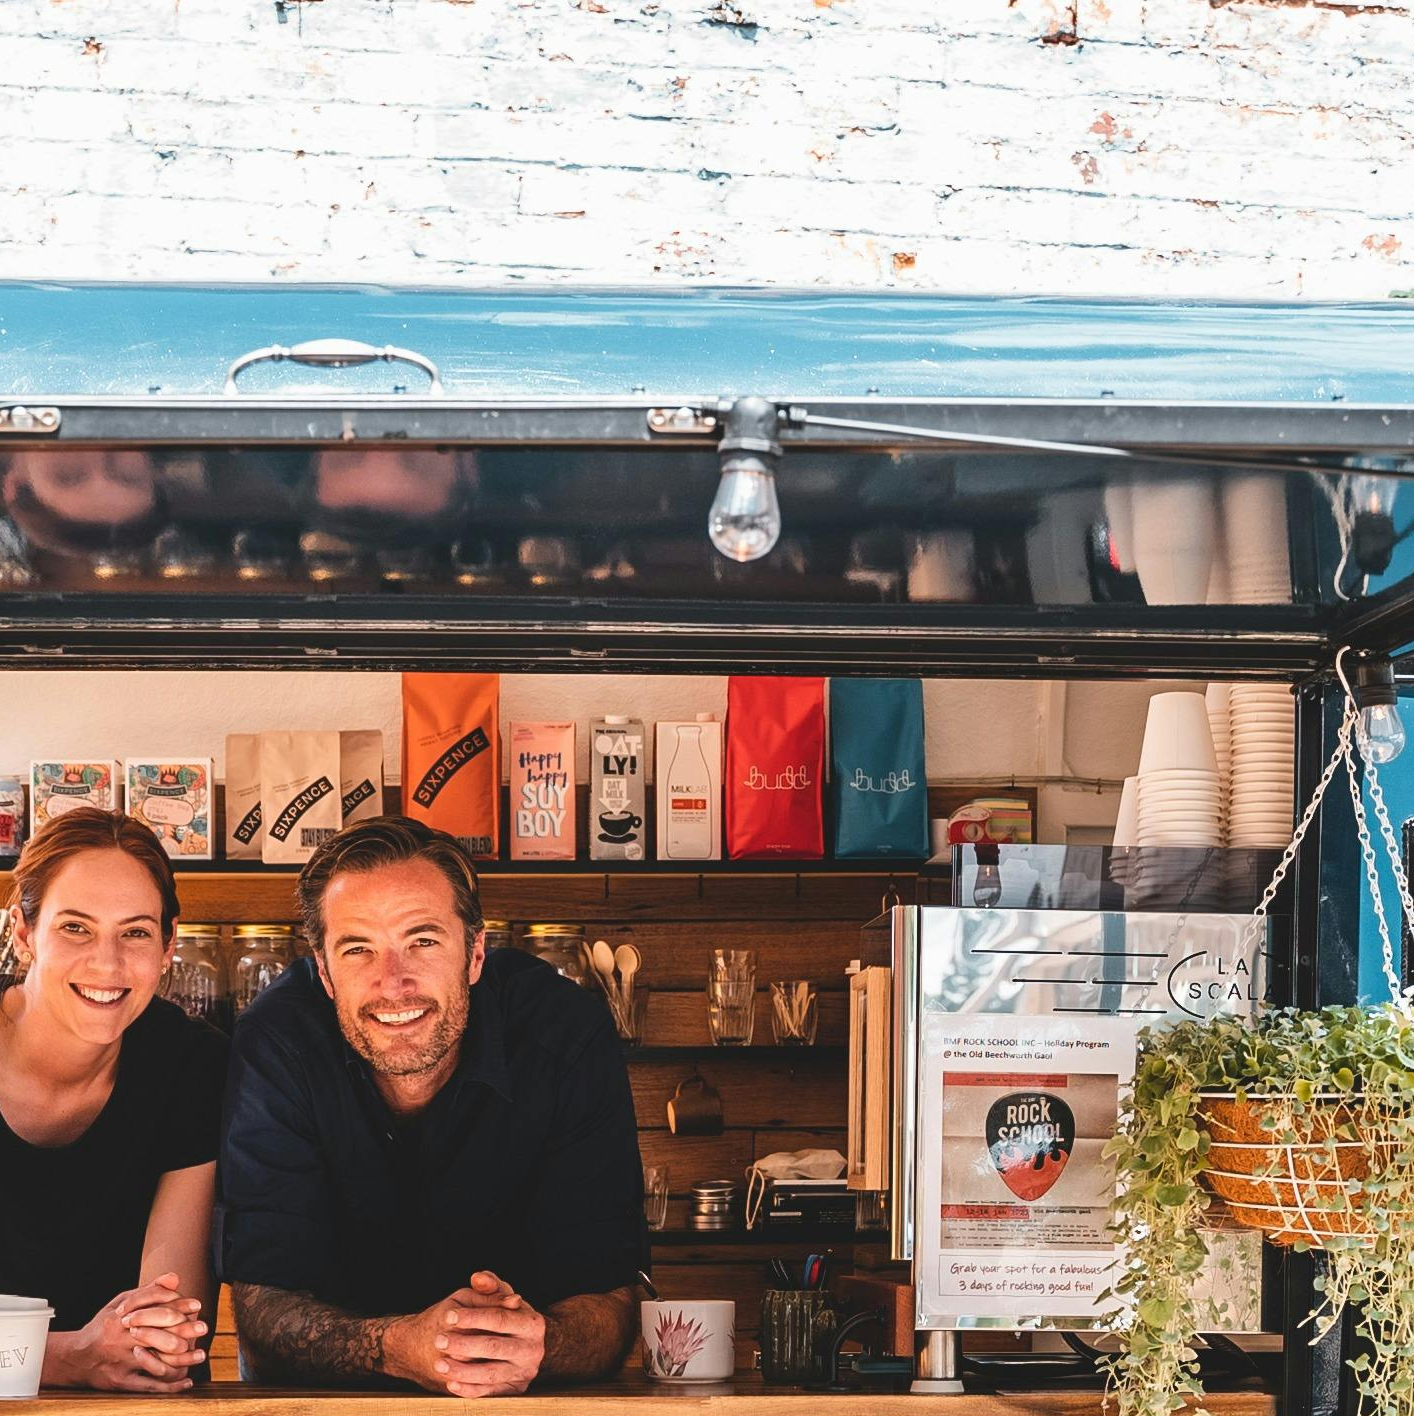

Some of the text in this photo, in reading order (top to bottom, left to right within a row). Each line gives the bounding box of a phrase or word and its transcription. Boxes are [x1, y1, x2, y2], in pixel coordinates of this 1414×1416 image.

[418, 733, 485, 803] SIXPENCE
[519, 752, 562, 771] Happy
[603, 755, 637, 775] LY!
[527, 769, 567, 788] happy
[274, 779, 330, 837] SIXPENCE
[238, 809, 262, 840] SIXP
[517, 810, 566, 837] BOY
[1218, 957, 1249, 975] LA
[1188, 982, 1273, 1001] SCALA
[963, 1038, 986, 1046] ROCK
[987, 1038, 1019, 1047] SCHOOL
[1021, 1039, 1036, 1047] INC
[1044, 1040, 1075, 1049] Holiday
[1076, 1040, 1110, 1049] Program
[985, 1051, 1033, 1060] Beechworth
[1034, 1052, 1053, 1060] Gaol
[1007, 1101, 1051, 1125] ROCK
[998, 1122, 1065, 1143] SCHOOL
[950, 1262, 977, 1274] Grab
[980, 1265, 1000, 1277] your
[1005, 1265, 1027, 1277] spot
[1032, 1264, 1045, 1275] for
[1060, 1264, 1102, 1275] fabulous
[959, 1280, 1094, 1294] 3 days of rocking good fun!
